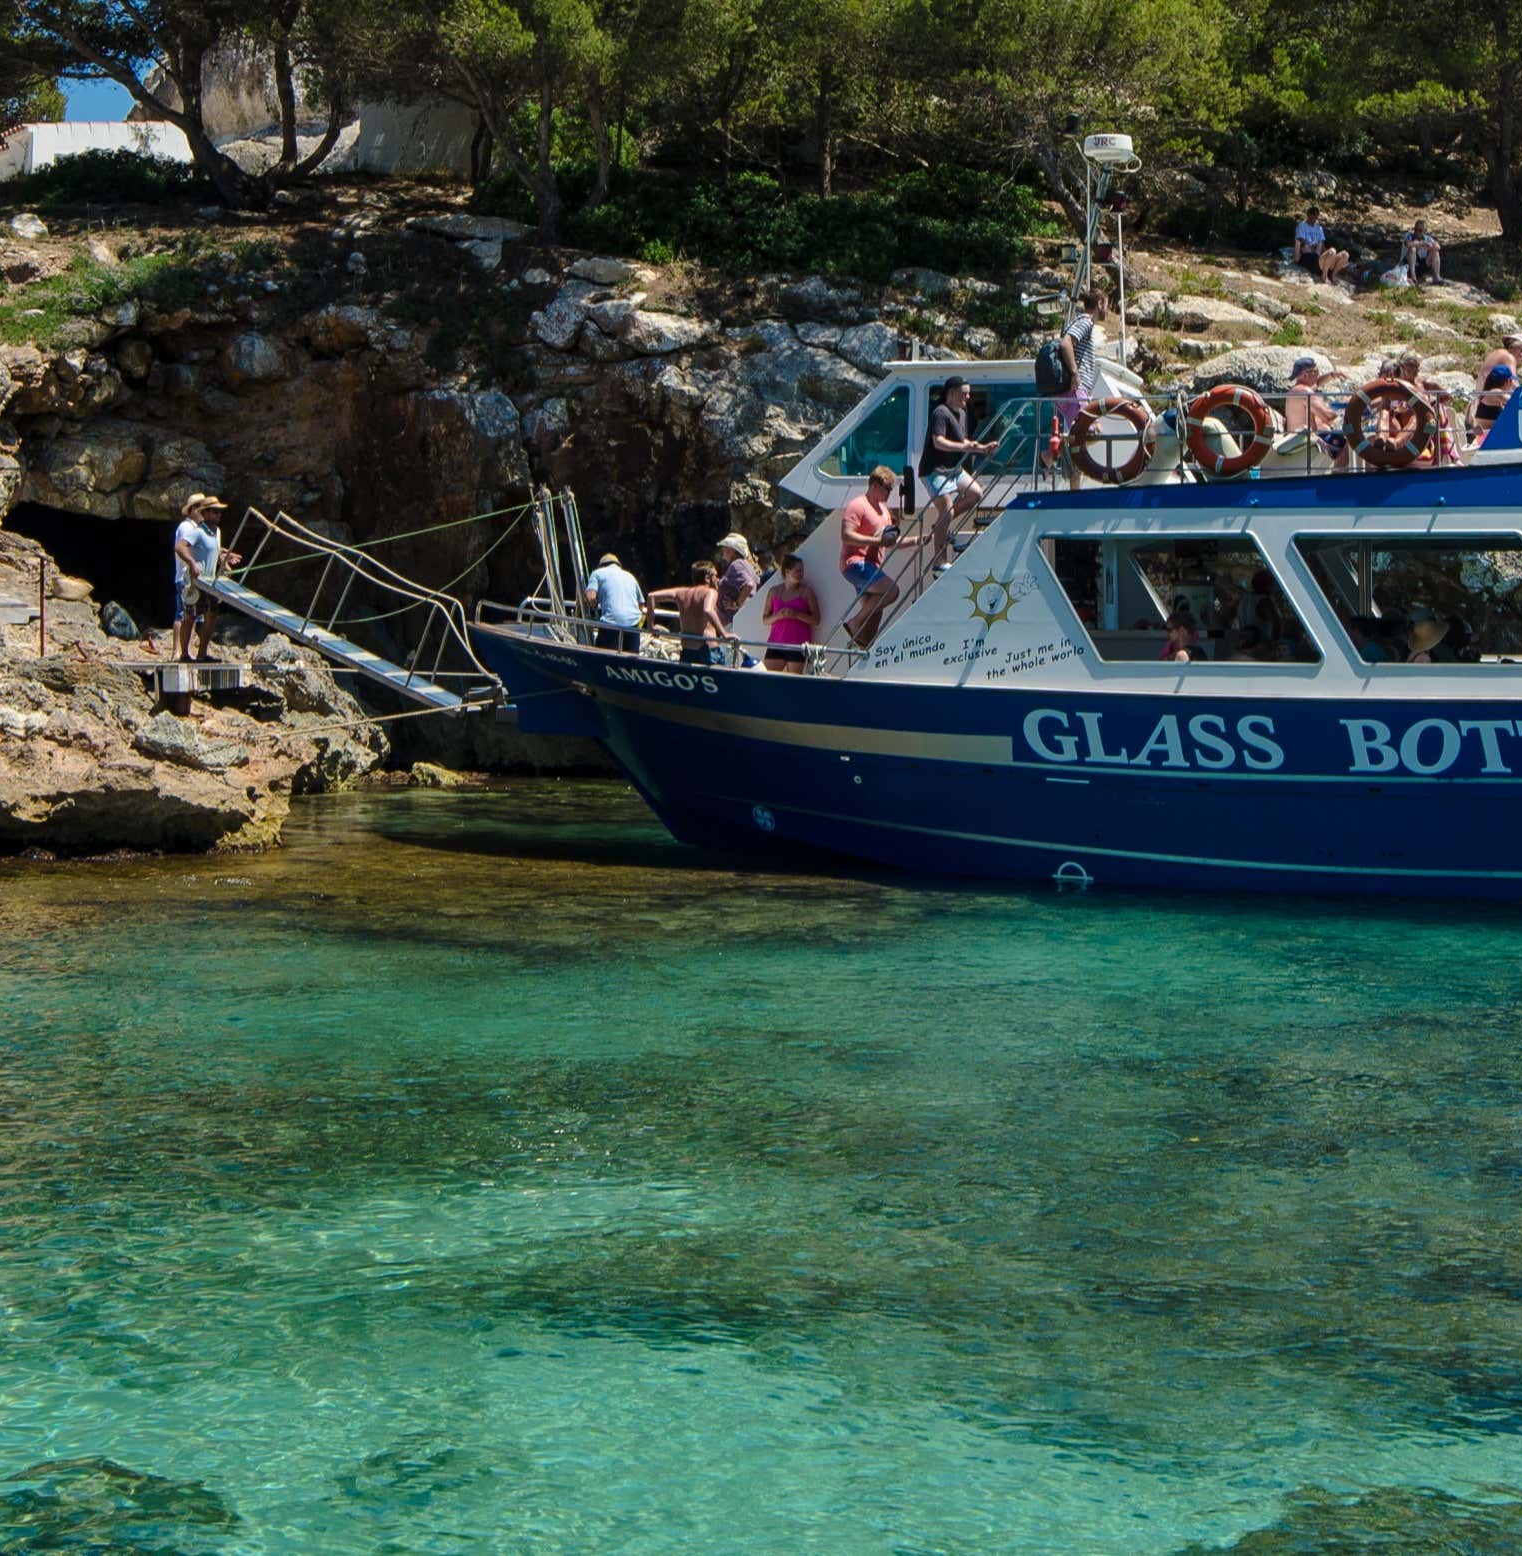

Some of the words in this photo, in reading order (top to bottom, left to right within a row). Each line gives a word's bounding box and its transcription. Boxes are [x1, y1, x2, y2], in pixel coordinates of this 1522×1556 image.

[875, 645, 896, 657] Soy
[875, 658, 888, 669] en
[893, 651, 904, 664] el
[910, 642, 945, 659] mundo
[943, 647, 998, 666] exclusive
[962, 638, 985, 650] I'm
[1005, 648, 1032, 664] Just
[1038, 643, 1054, 656] me
[1061, 638, 1071, 649] in
[605, 664, 719, 694] AMIGO'S
[986, 667, 1006, 681] the
[1012, 657, 1046, 674] whole
[1023, 708, 1285, 770] GLASS
